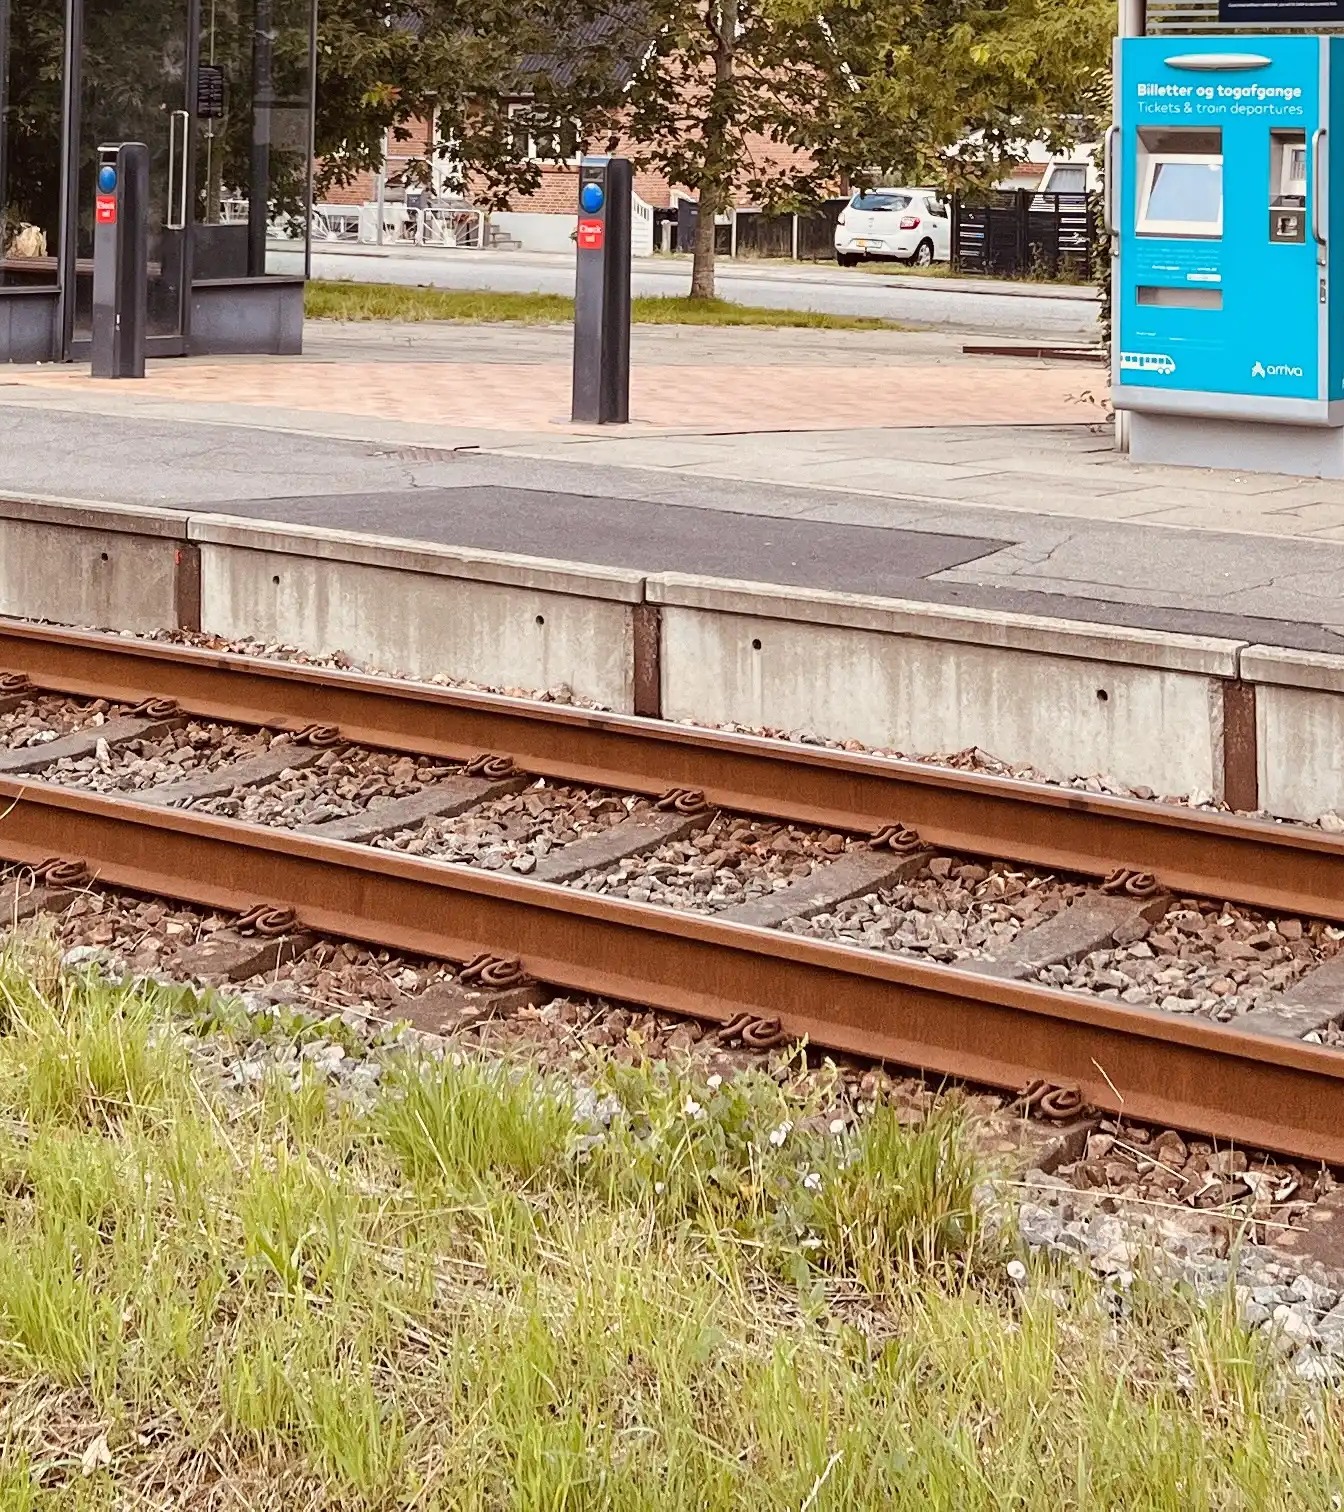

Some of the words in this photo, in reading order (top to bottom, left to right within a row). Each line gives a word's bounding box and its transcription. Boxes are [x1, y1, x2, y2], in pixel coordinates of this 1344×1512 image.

[1137, 83, 1193, 97] Billetter
[1196, 87, 1214, 99] og
[1217, 84, 1302, 100] togafgange
[1137, 101, 1181, 114] Tickets
[1184, 102, 1192, 113] &
[1196, 102, 1227, 114] train
[1230, 102, 1304, 116] departures
[579, 225, 602, 233] Check
[1266, 364, 1303, 377] arriva
